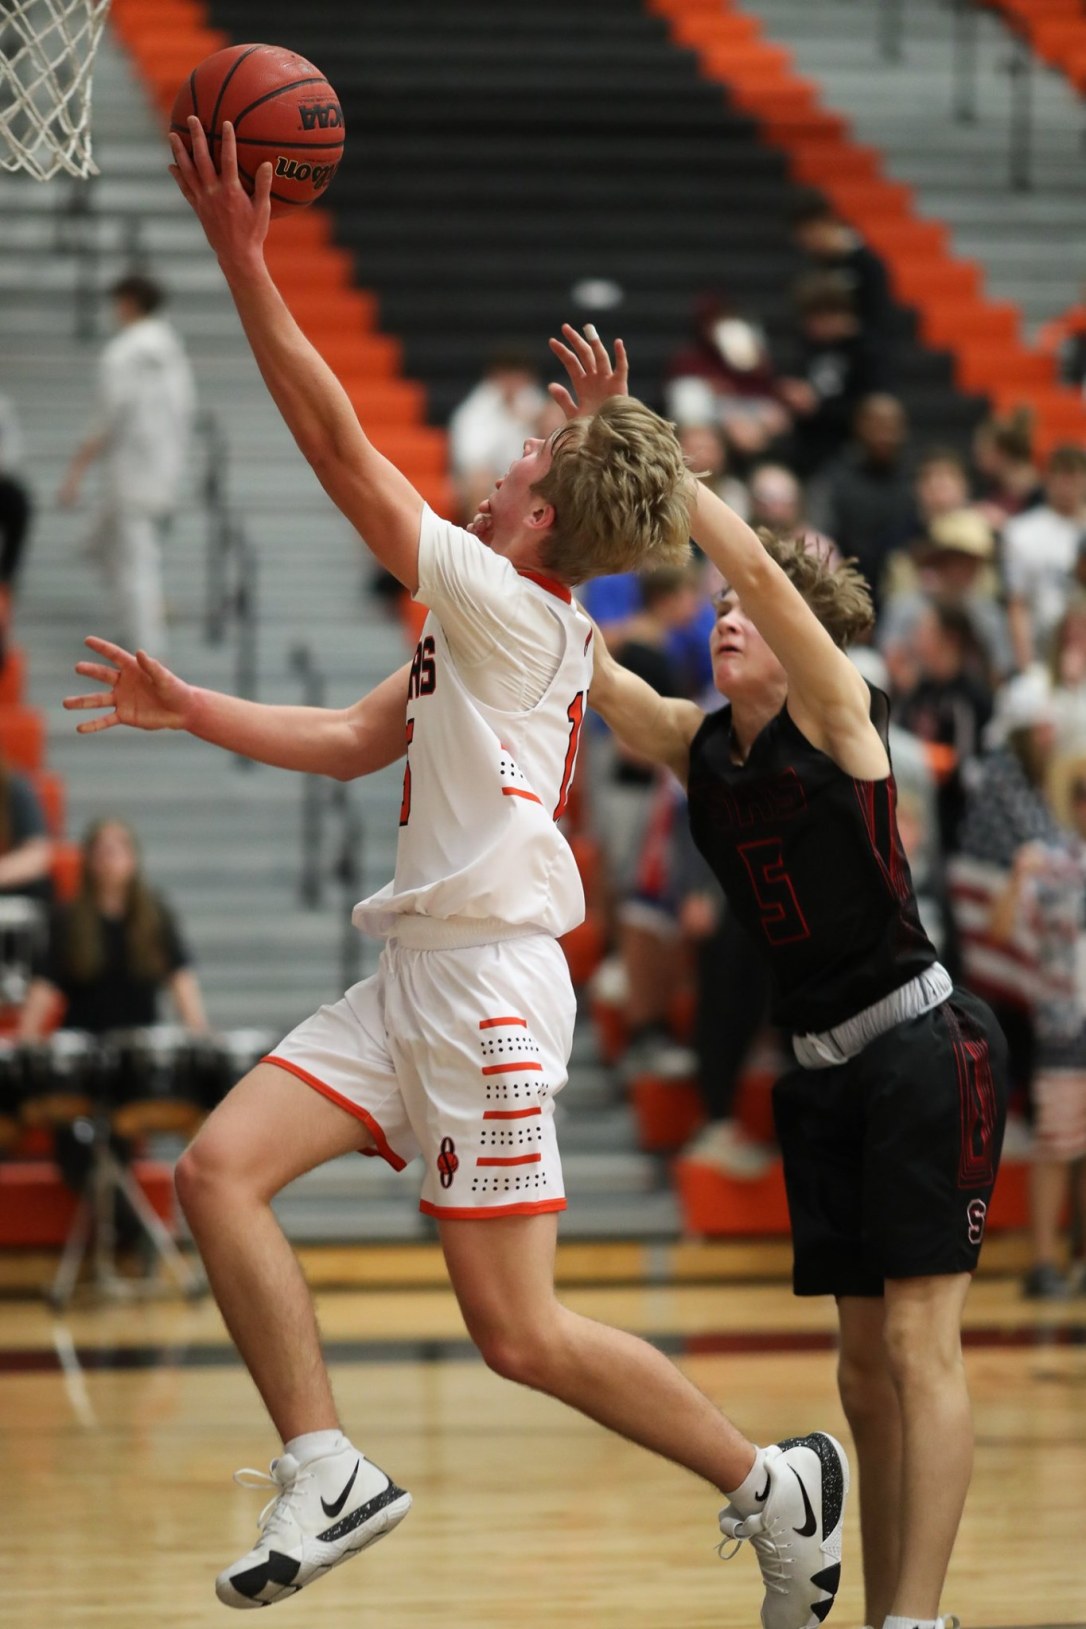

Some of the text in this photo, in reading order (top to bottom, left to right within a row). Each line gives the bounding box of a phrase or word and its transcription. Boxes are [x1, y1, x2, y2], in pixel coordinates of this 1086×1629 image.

[299, 103, 344, 131] CAA
[553, 689, 589, 823] 1
[737, 837, 811, 946] 5
[967, 1199, 986, 1244] S
